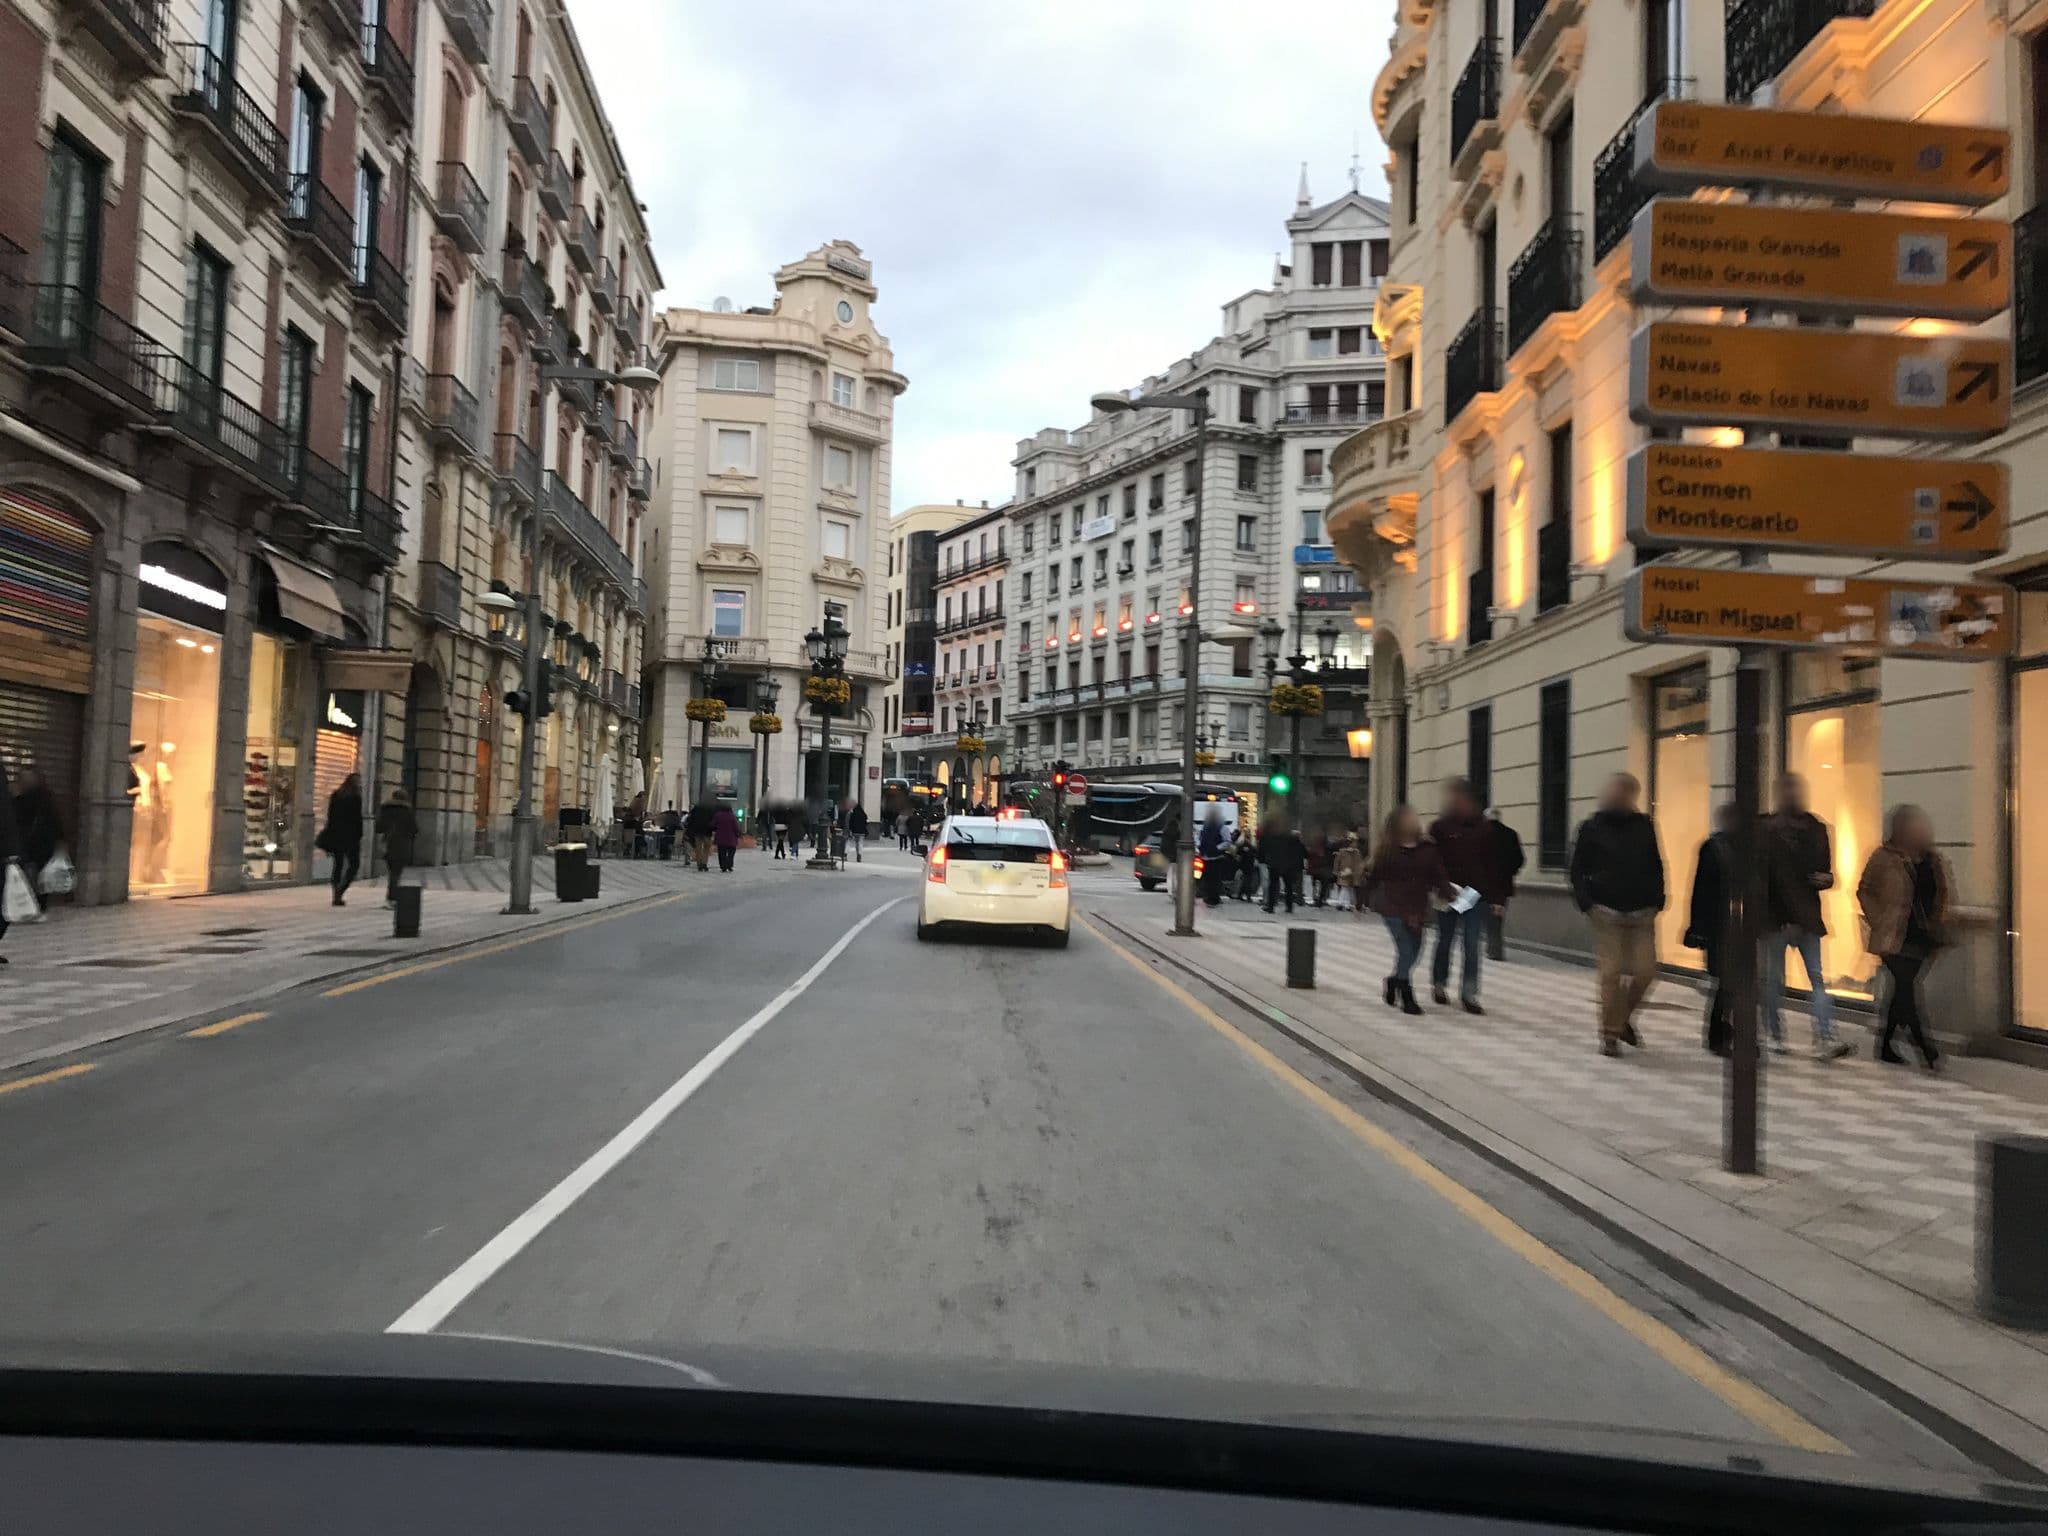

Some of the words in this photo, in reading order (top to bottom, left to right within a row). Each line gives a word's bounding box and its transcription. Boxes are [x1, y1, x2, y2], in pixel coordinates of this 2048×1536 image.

[1661, 231, 1749, 254] Hesperia
[1760, 236, 1841, 257] Granada
[1723, 265, 1805, 286] Granada
[1658, 355, 1721, 374] Navas
[1657, 384, 1731, 404] Palacio
[1739, 390, 1762, 406] de
[1770, 388, 1799, 408] los
[1807, 391, 1870, 412] Navas
[1657, 451, 1723, 469] Hoteles
[1657, 475, 1752, 499] Carmen
[1656, 505, 1799, 532] Montecarlo
[1653, 575, 1700, 592] Hotel
[1653, 603, 1709, 625] Juan
[1720, 607, 1802, 633] Miguel
